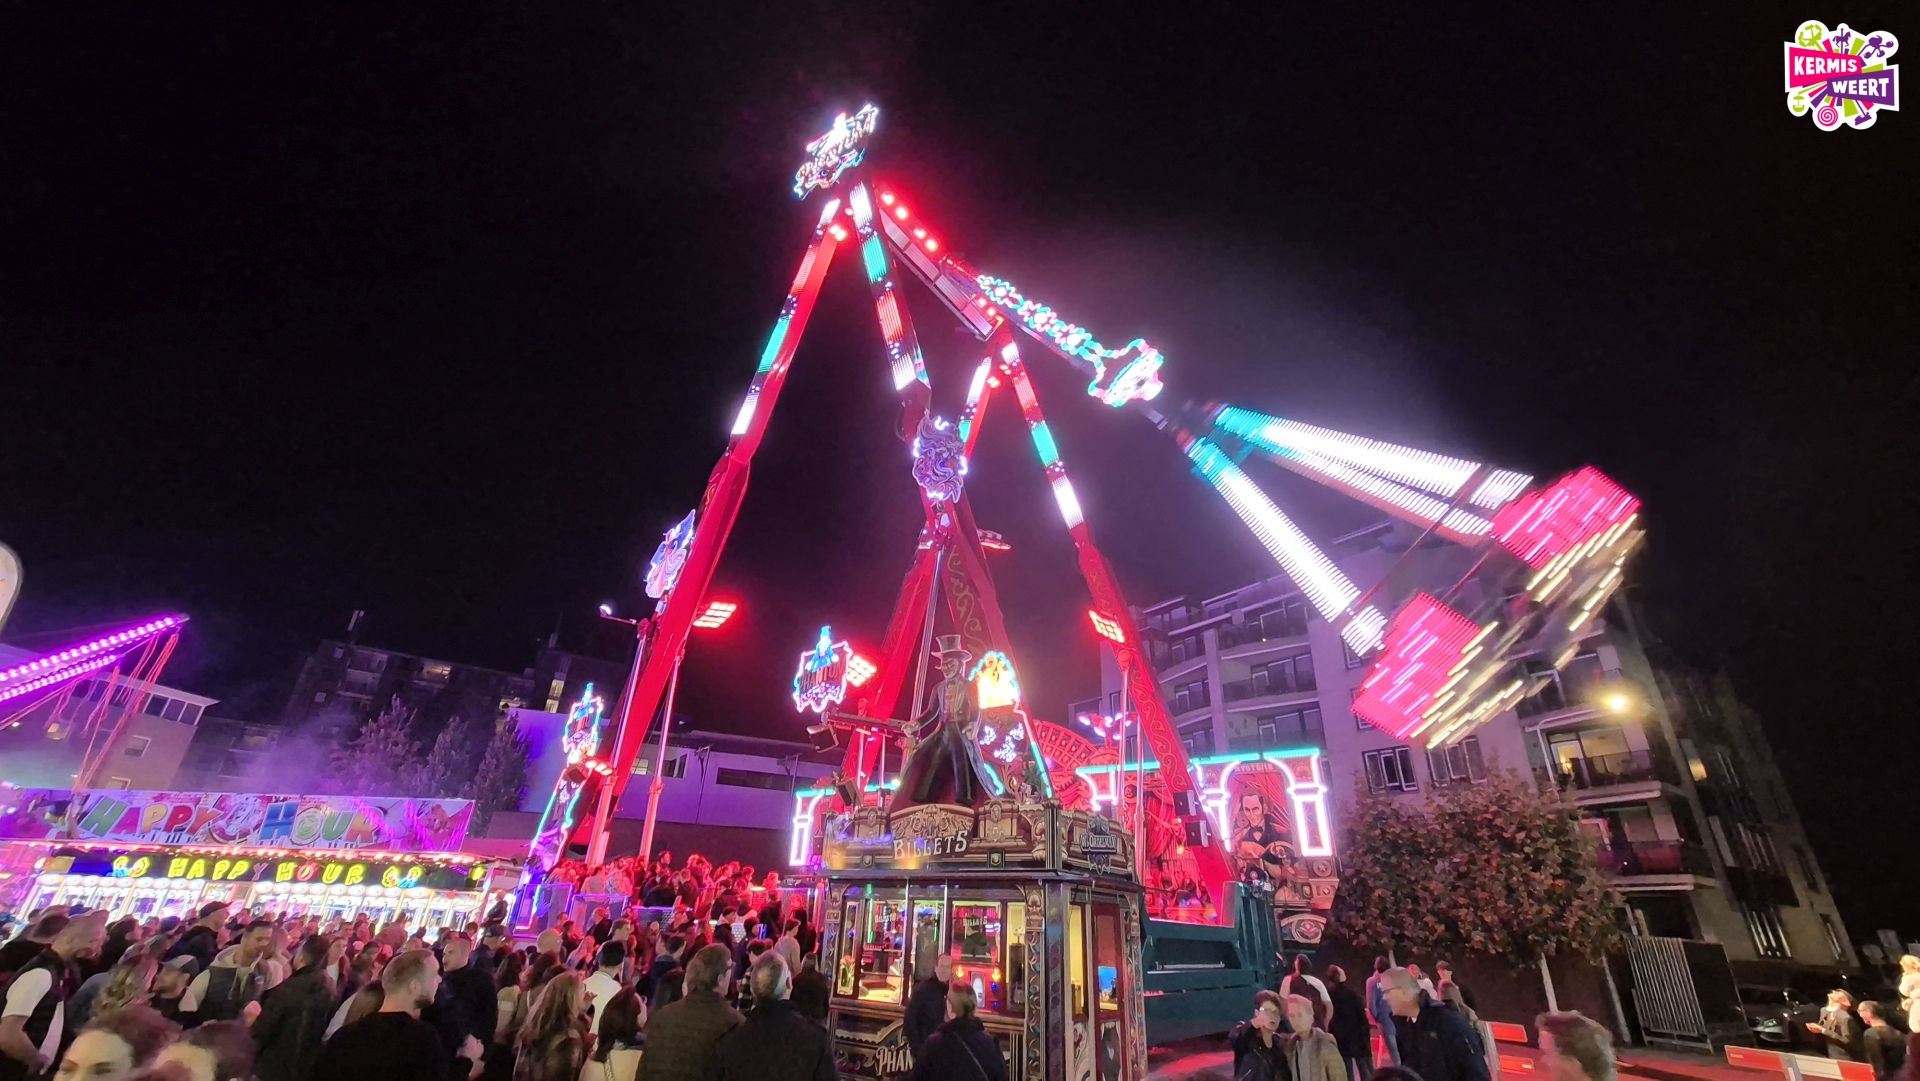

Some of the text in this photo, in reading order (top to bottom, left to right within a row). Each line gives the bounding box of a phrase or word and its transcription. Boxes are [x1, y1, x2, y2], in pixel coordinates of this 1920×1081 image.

[78, 795, 382, 846] HAPPY HOUR
[893, 830, 968, 860] BILLETS
[167, 856, 368, 886] HAPPY HOUR
